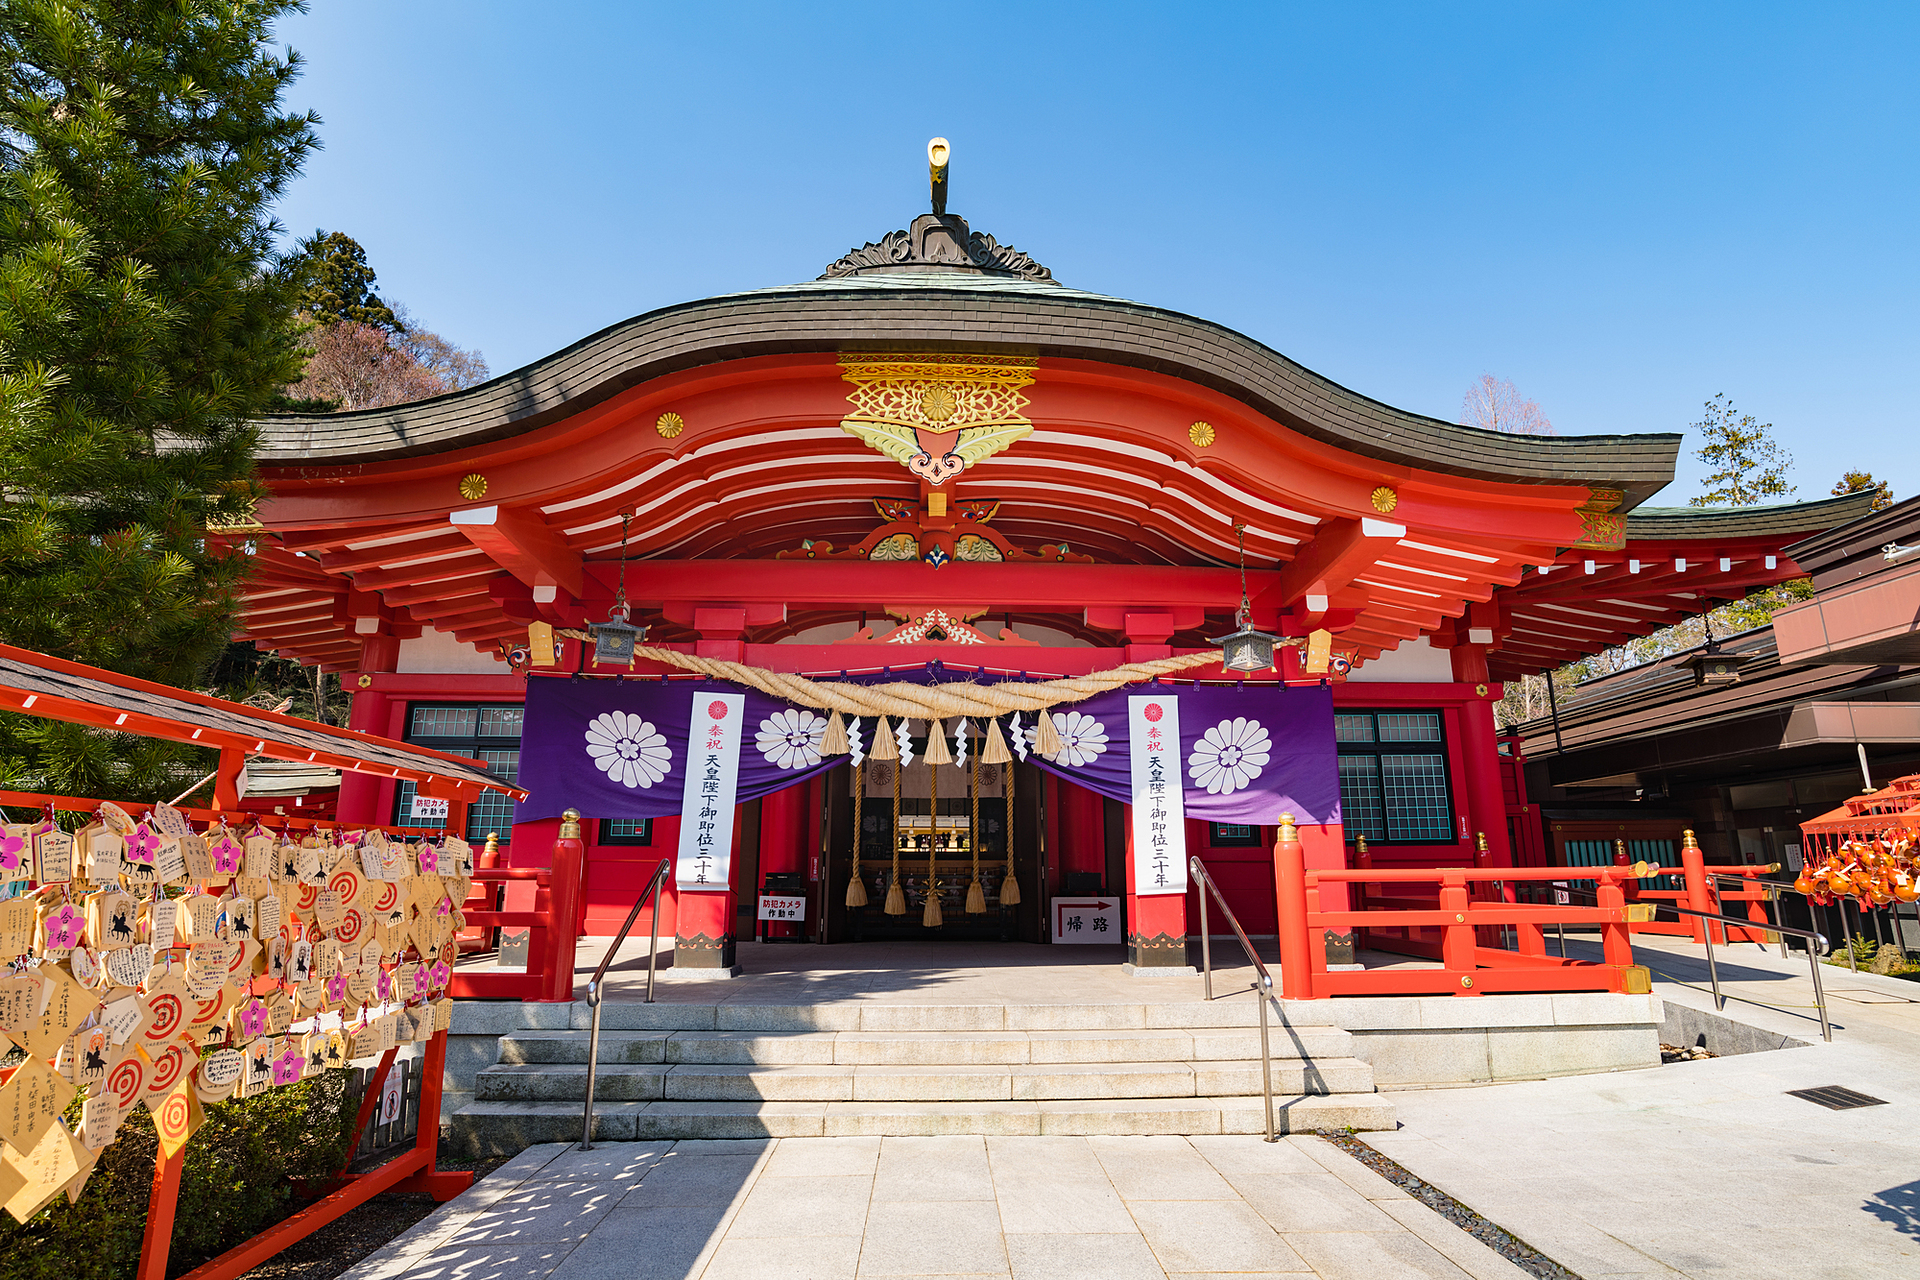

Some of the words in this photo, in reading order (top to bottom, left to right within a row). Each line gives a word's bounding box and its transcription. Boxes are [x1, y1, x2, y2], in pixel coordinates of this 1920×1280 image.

[706, 724, 724, 750] 奉祝
[1146, 727, 1164, 752] 奉祝
[421, 808, 446, 816] 作動中
[694, 754, 721, 885] 天皇陛下御即位三十年
[1147, 756, 1170, 887] 天皇陛下御即位三十年
[135, 829, 149, 857] 合格
[221, 843, 231, 868] 合格
[762, 899, 801, 909] 防犯カメラ
[768, 909, 795, 918] 作動中
[56, 912, 73, 943] 合格
[1067, 916, 1110, 932] 帰路
[249, 1005, 259, 1031] 合格
[281, 1055, 294, 1079] 合格
